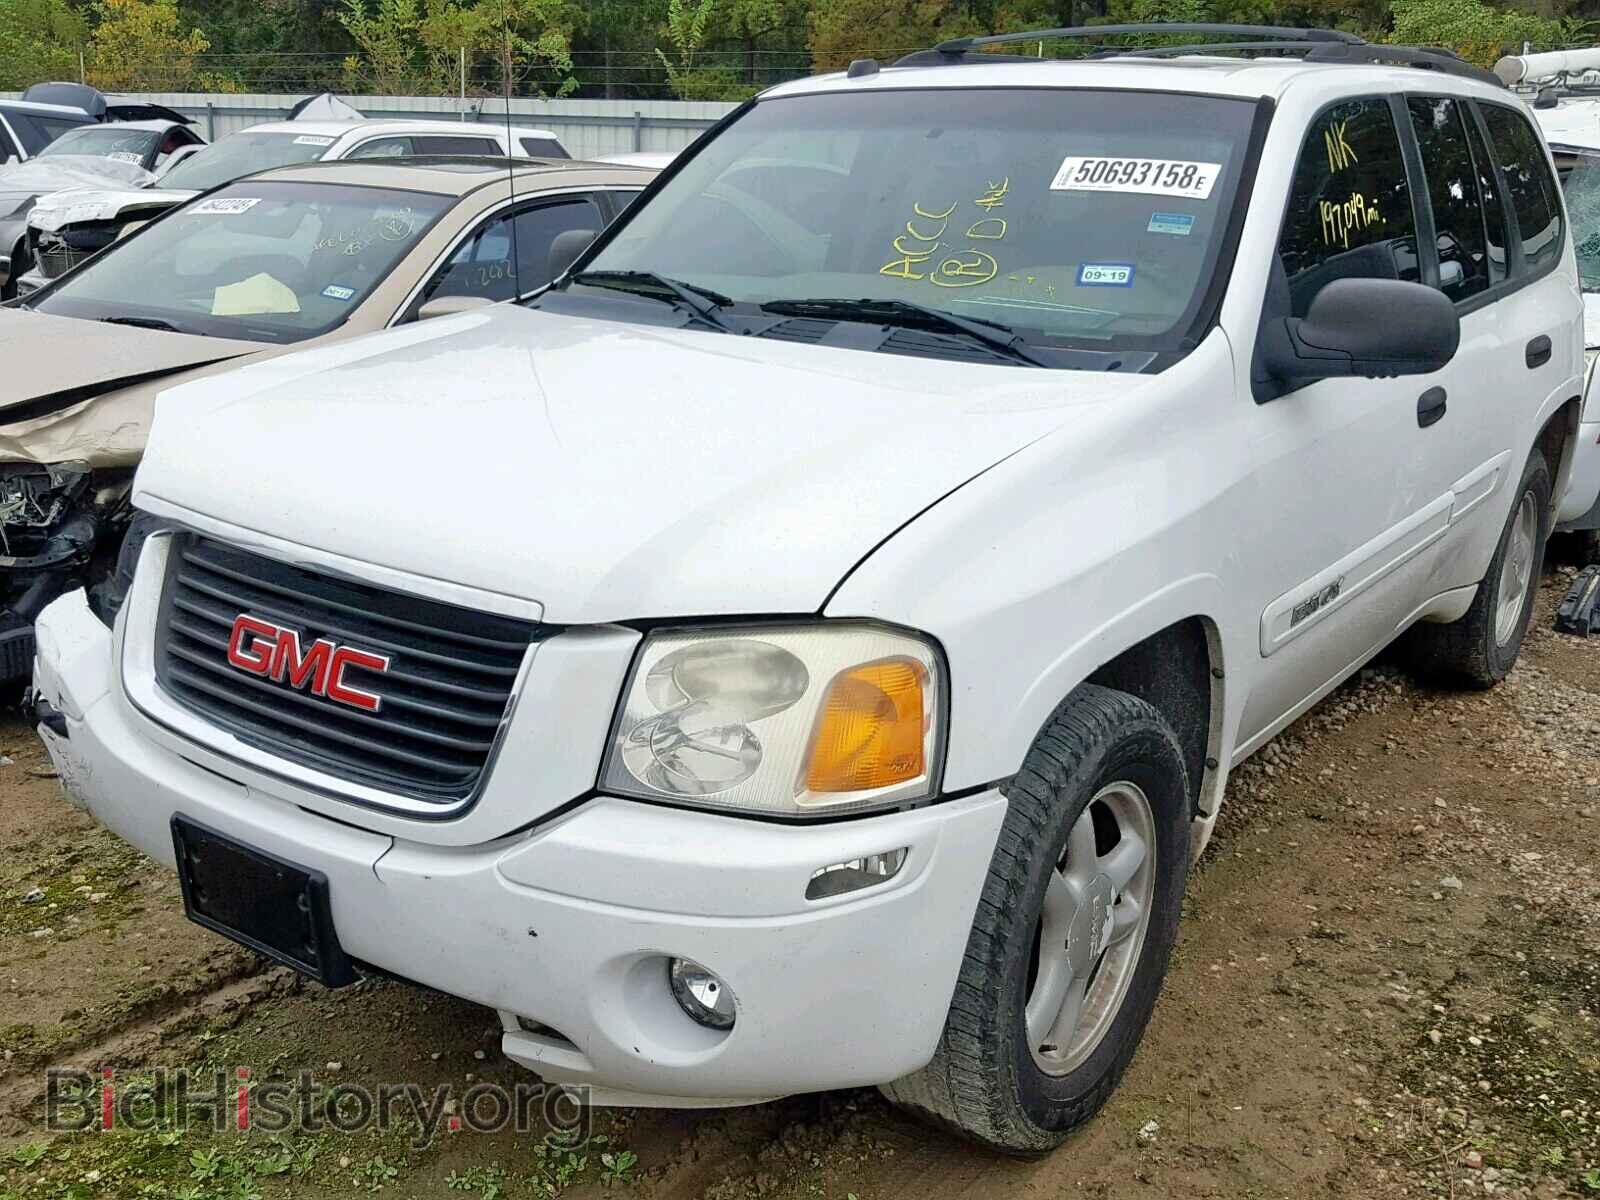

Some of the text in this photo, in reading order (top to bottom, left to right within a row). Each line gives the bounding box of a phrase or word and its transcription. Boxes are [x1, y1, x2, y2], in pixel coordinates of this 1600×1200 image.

[1324, 121, 1358, 173] NK
[1074, 159, 1198, 189] 50693158
[228, 614, 389, 712] GMC
